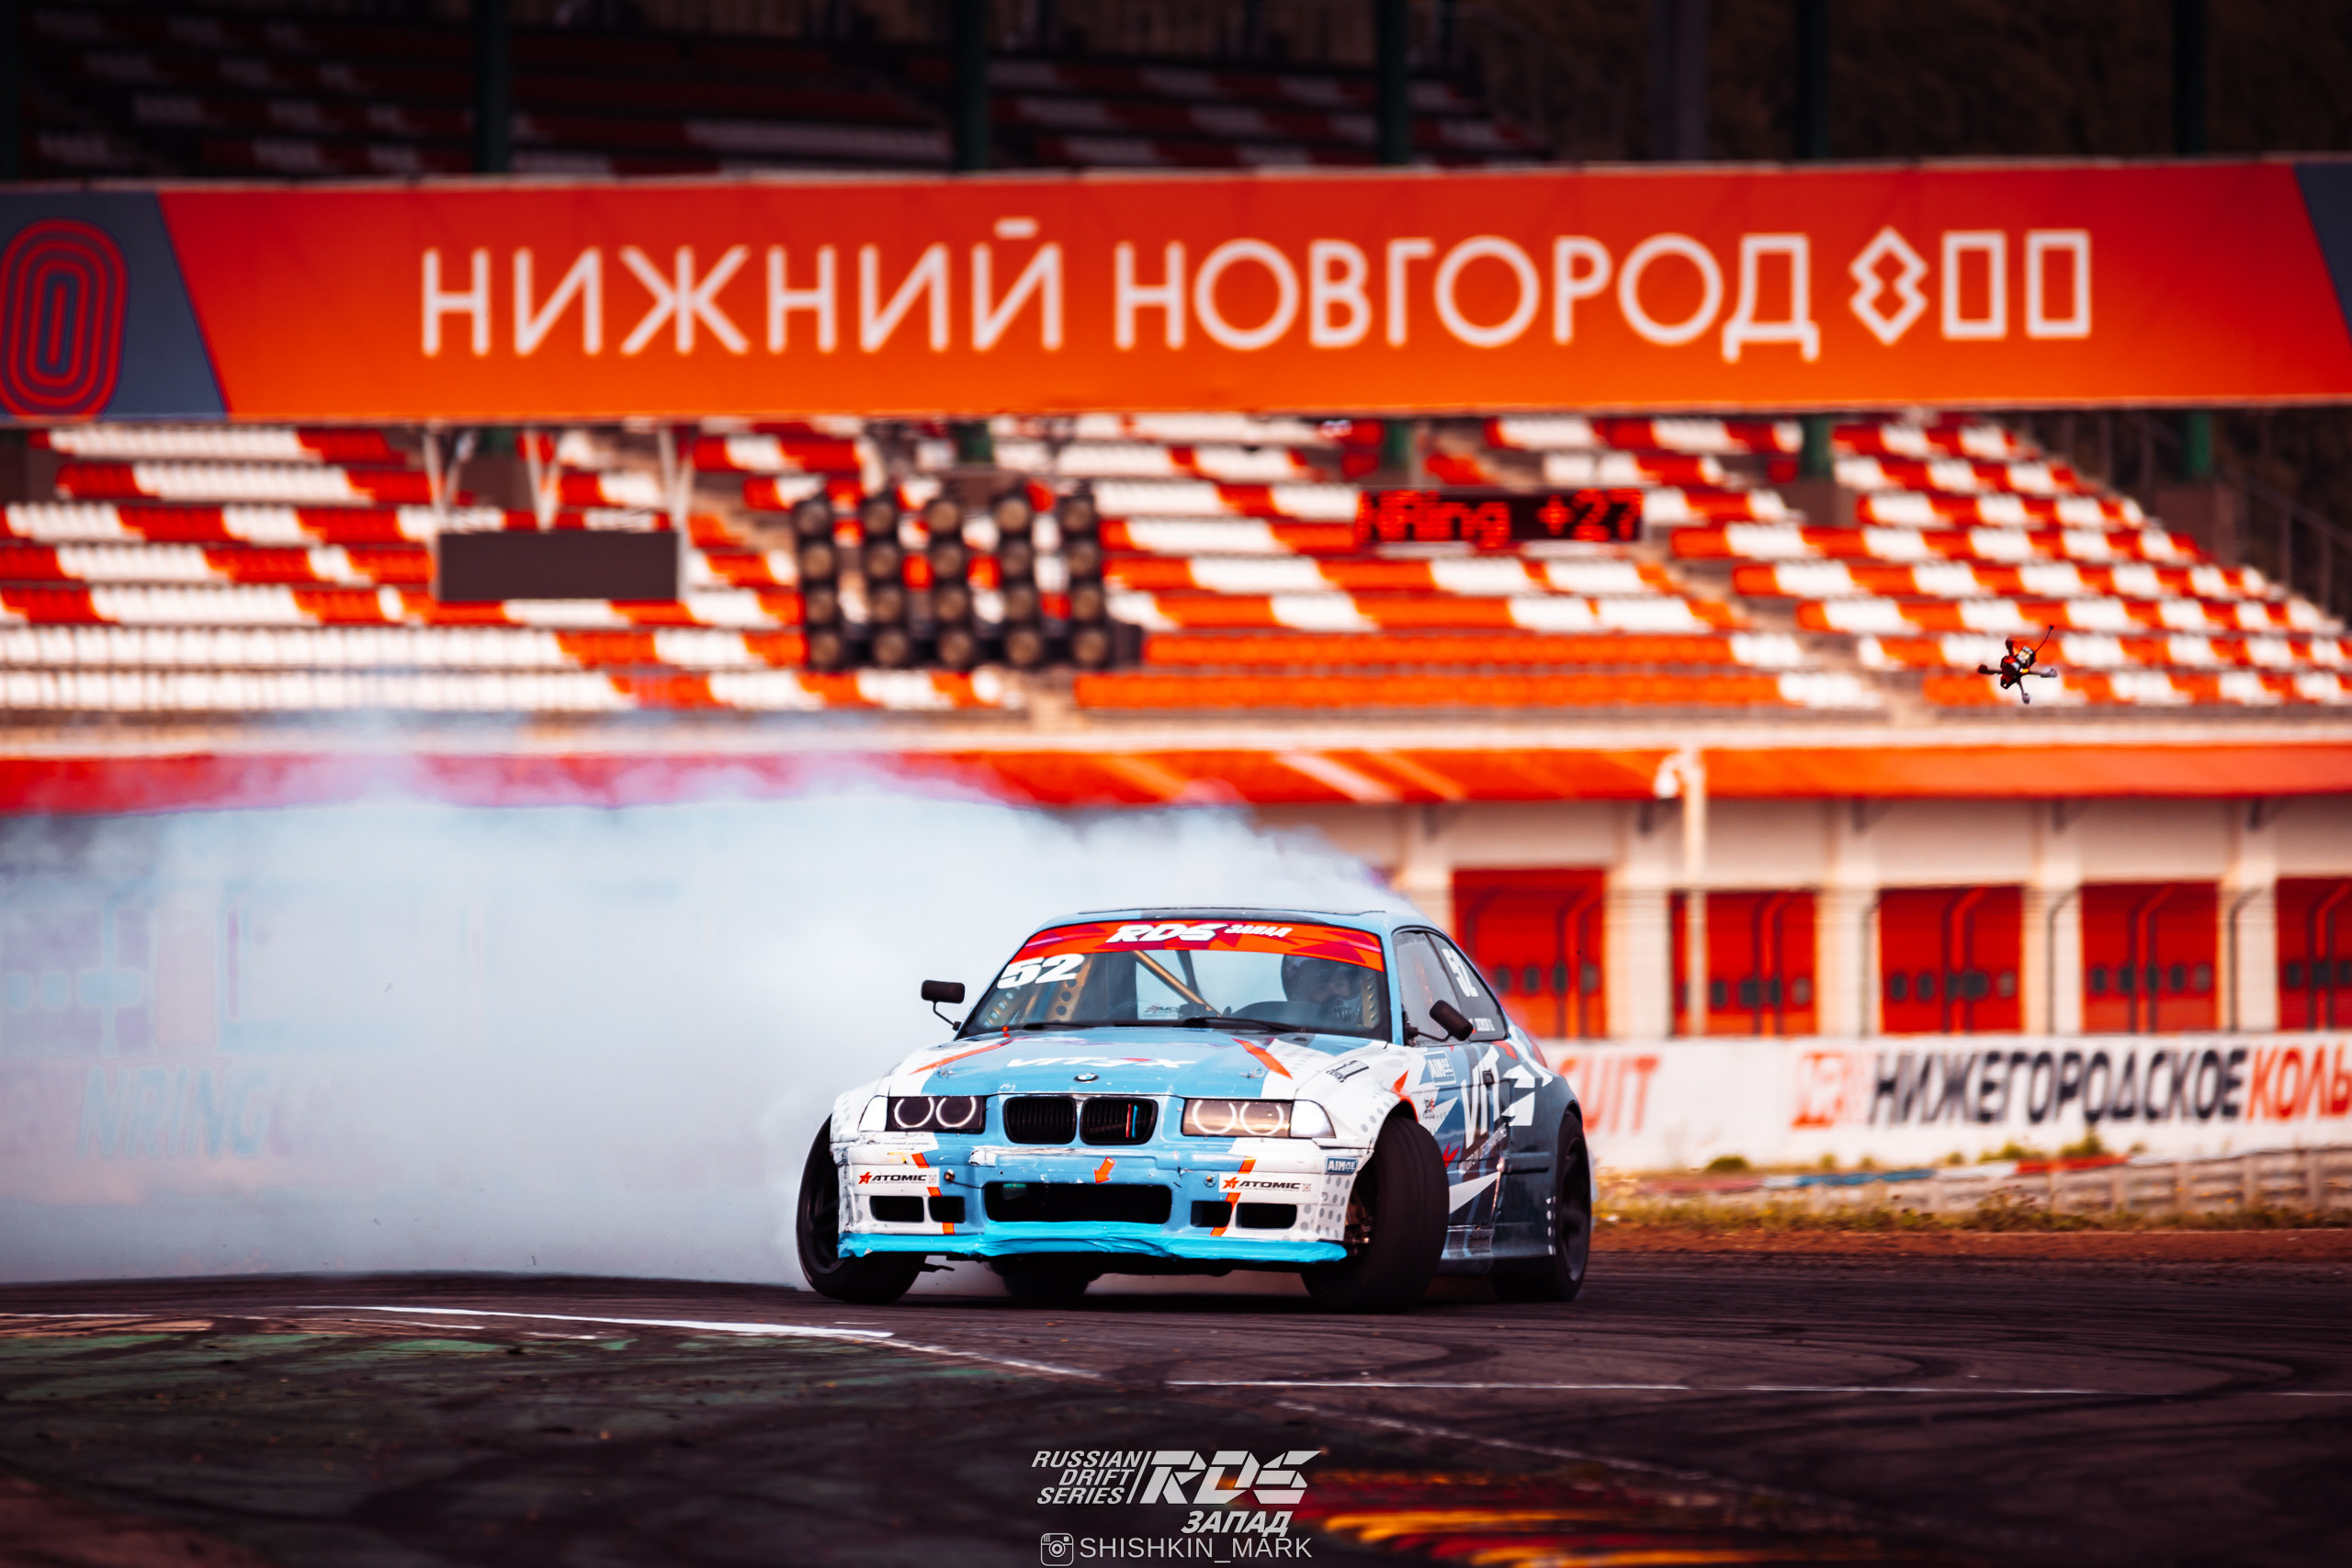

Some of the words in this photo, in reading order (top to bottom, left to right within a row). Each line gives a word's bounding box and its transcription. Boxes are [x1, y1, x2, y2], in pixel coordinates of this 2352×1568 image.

[421, 217, 1064, 356] НИЖНИЙ
[1113, 232, 1822, 363] НОВГОРОД
[1537, 488, 1643, 542] +27
[1105, 923, 1229, 943] RDS
[997, 953, 1085, 989] 52
[77, 1064, 270, 1158] NRING
[1870, 1048, 2247, 1126] НИЖЕГОРОДСКОЕ
[1239, 1180, 1301, 1190] ATOMIC
